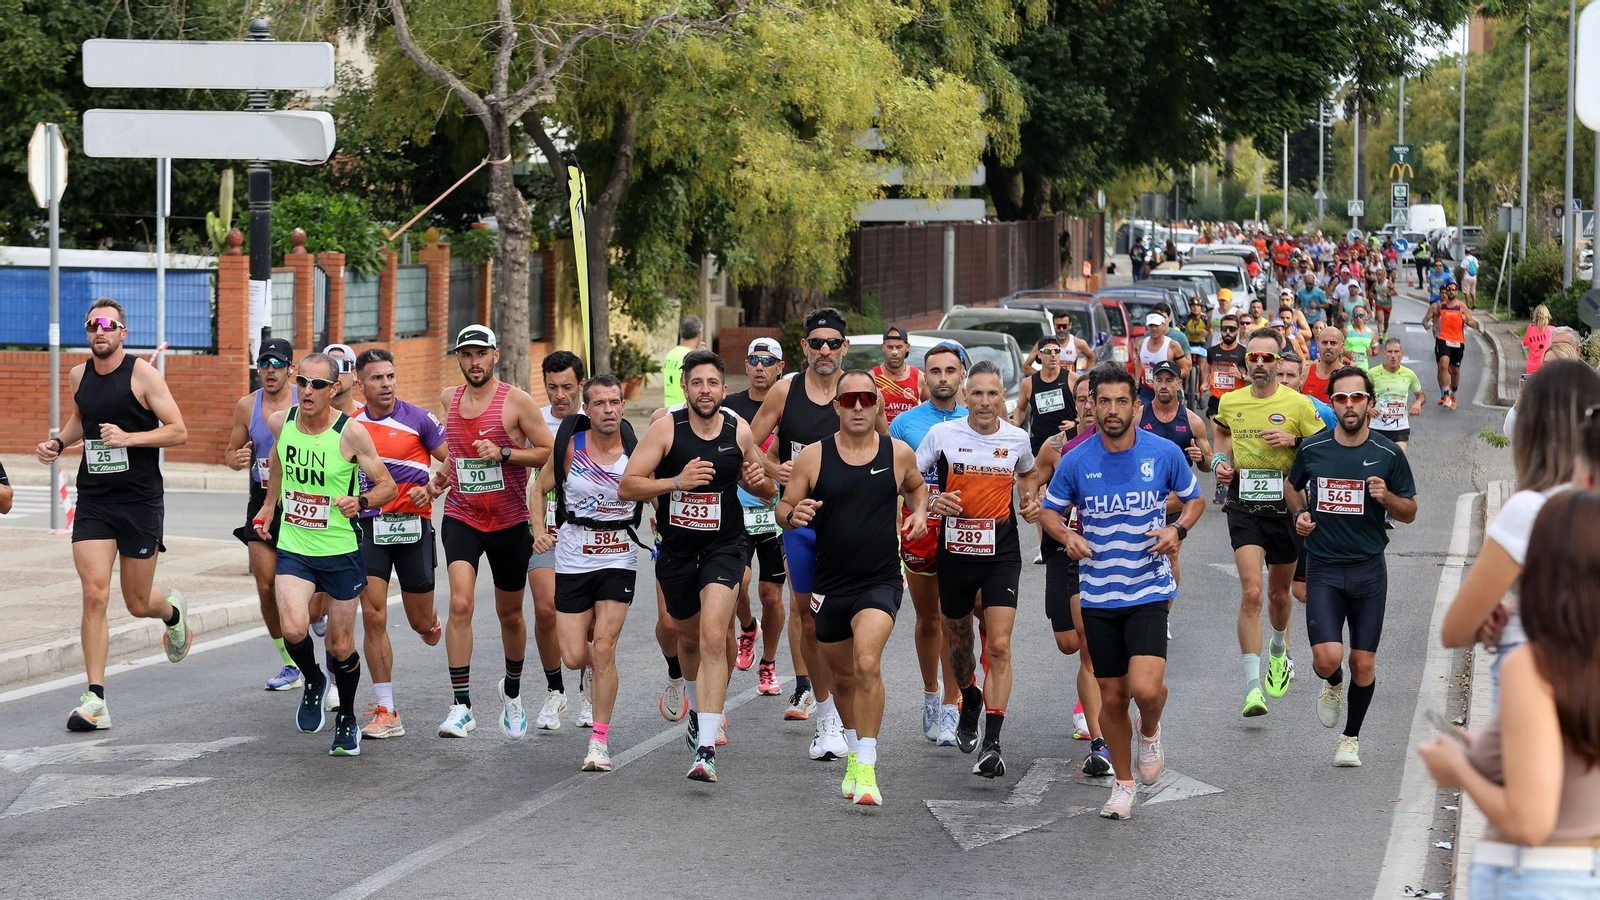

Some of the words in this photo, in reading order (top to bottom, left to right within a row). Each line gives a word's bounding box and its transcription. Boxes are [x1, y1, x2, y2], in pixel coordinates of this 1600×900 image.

[1045, 397, 1055, 406] 69
[97, 450, 111, 462] 25
[286, 445, 325, 469] RUN
[966, 465, 1012, 474] RUBYSAN
[285, 465, 325, 487] RUN
[470, 470, 486, 482] 90
[1253, 480, 1268, 491] 22
[1084, 490, 1160, 514] CHAPIN
[1328, 490, 1352, 503] 545
[294, 503, 318, 518] 499
[681, 504, 709, 519] 433
[755, 513, 769, 524] 82
[389, 523, 406, 533] 44
[594, 532, 620, 544] 584
[957, 531, 983, 543] 289
